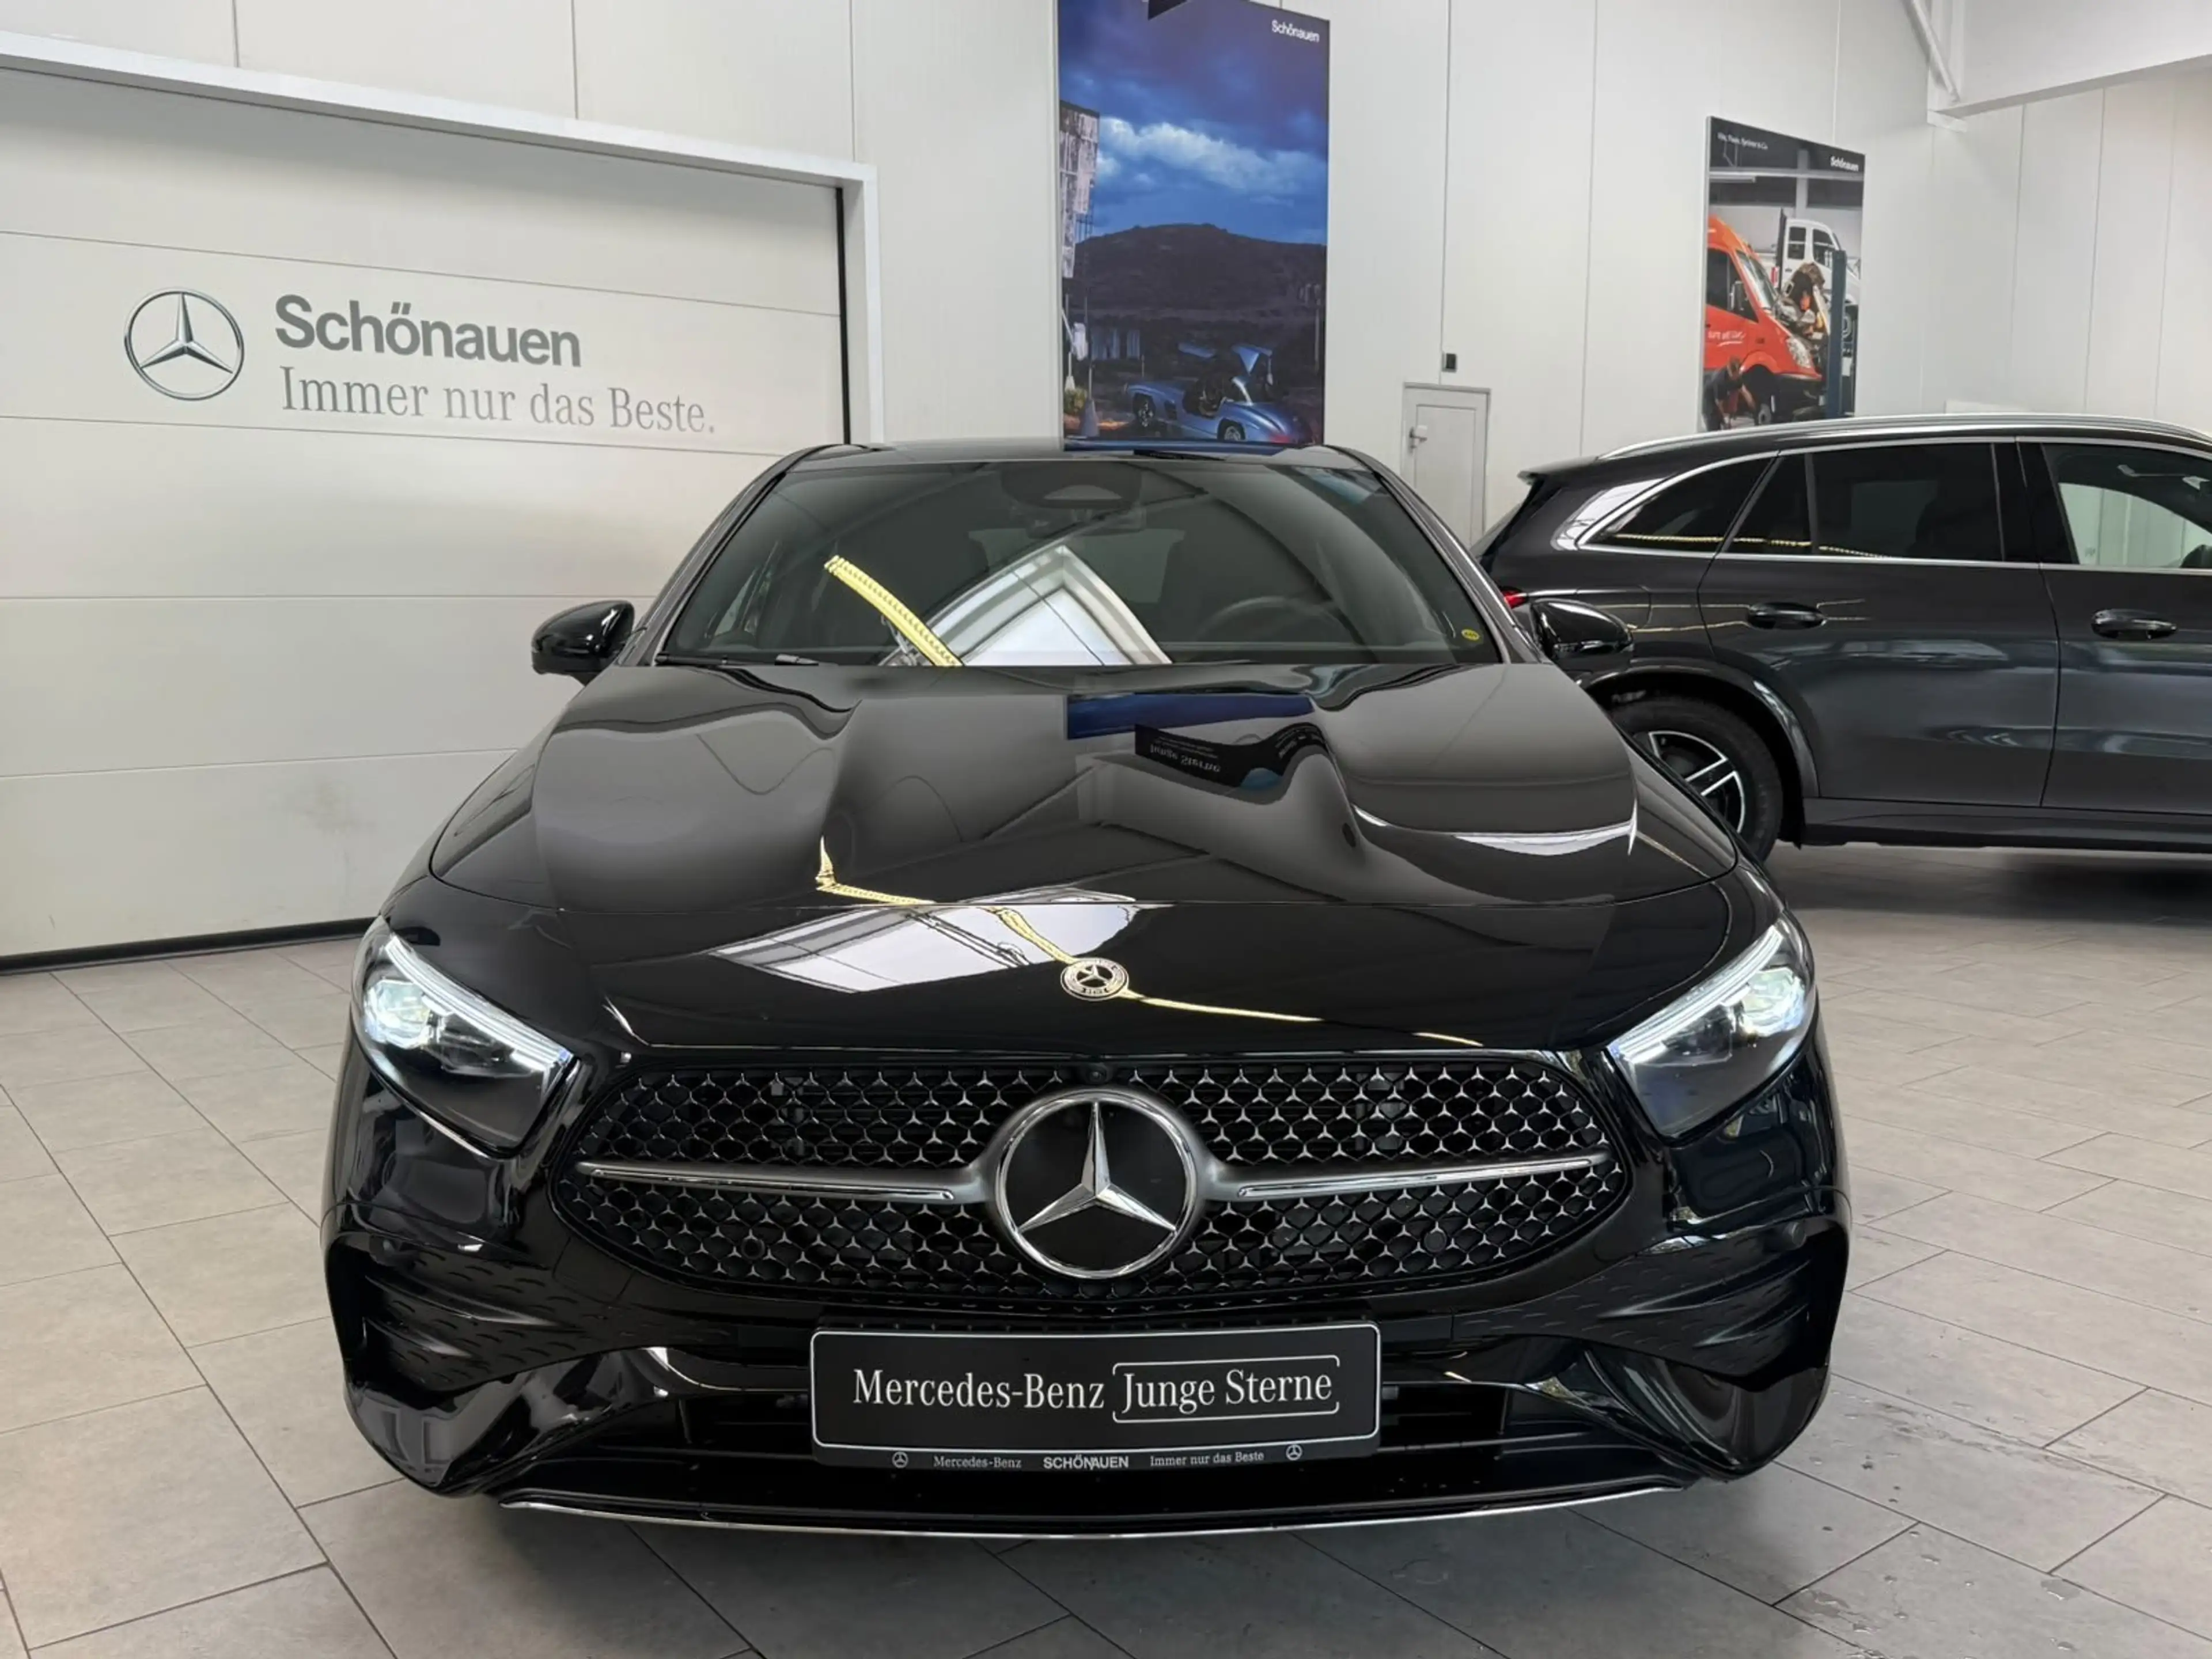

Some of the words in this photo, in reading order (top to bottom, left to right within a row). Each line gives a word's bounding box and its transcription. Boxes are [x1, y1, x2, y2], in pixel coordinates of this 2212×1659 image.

[1271, 20, 1320, 43] Schönauen
[275, 294, 582, 368] Schönauen
[278, 365, 429, 419] Immer
[442, 388, 516, 422] nur
[530, 382, 595, 427] das
[607, 387, 714, 434] Beste.
[854, 1369, 1105, 1409] Mercedes-Benz
[1122, 1373, 1215, 1414] Junge
[1226, 1369, 1332, 1405] Sterne
[933, 1456, 1022, 1469] Mercedes-Benz
[1042, 1453, 1129, 1471] SCHÖNAUEN
[1150, 1455, 1187, 1467] Immer
[1190, 1455, 1211, 1466] nur
[1212, 1452, 1232, 1464] das
[1234, 1450, 1265, 1463] Beste
